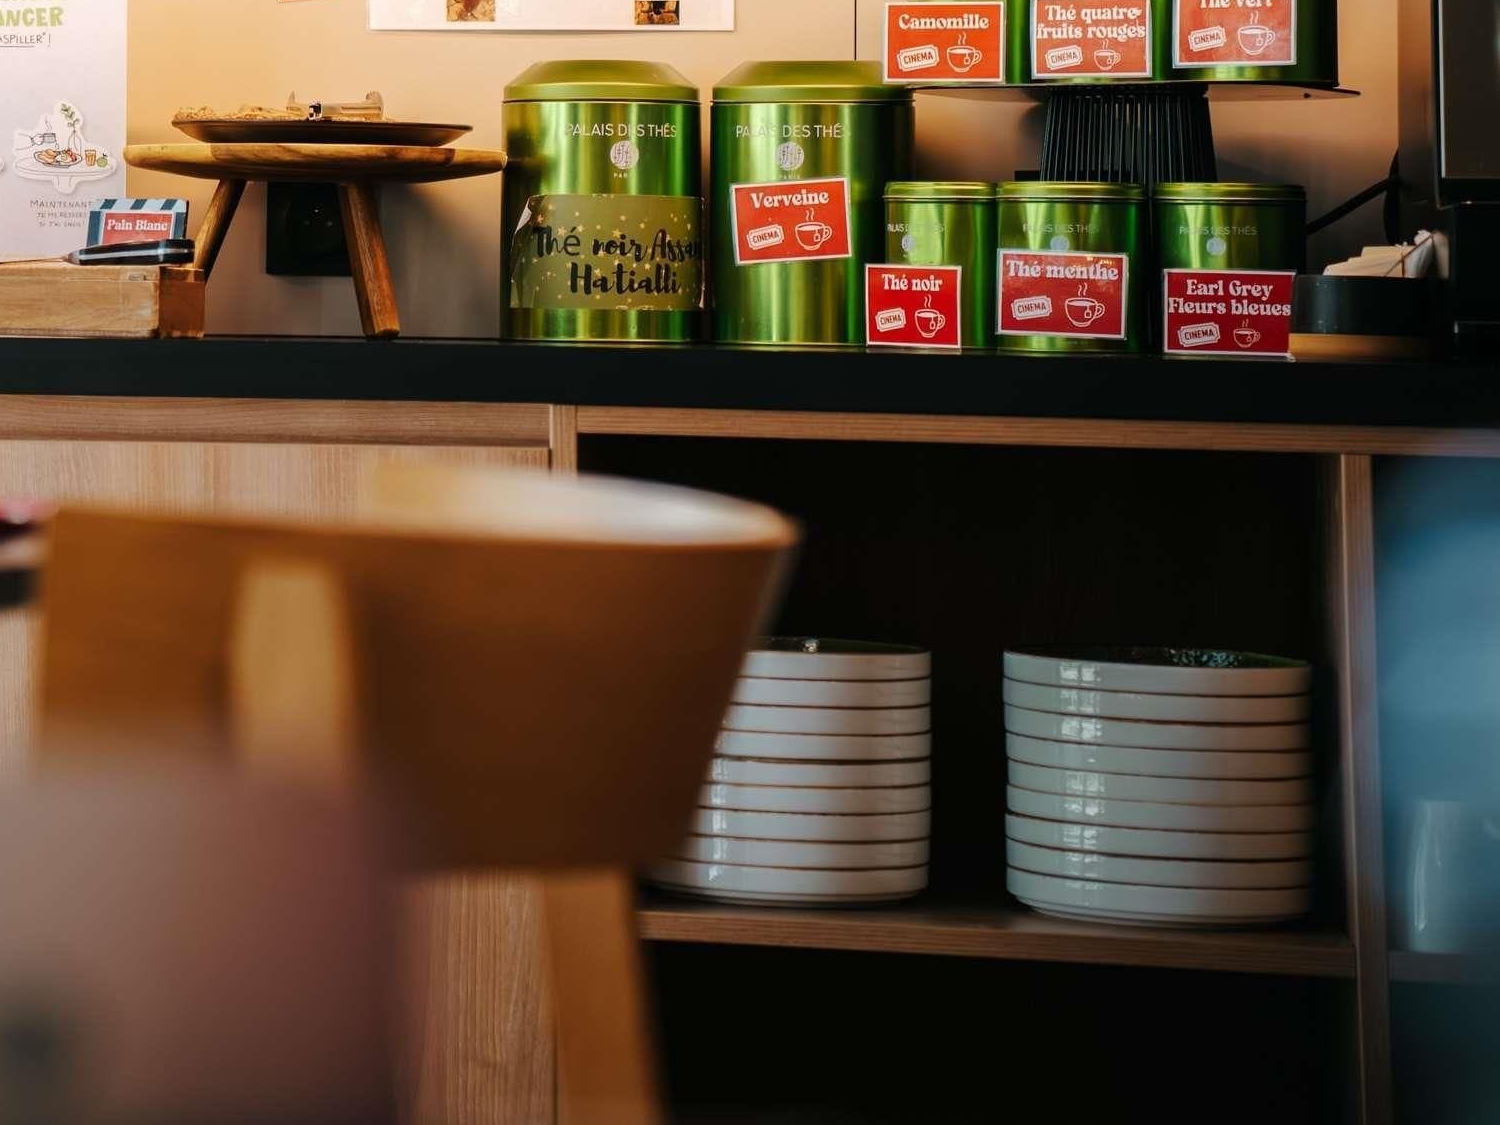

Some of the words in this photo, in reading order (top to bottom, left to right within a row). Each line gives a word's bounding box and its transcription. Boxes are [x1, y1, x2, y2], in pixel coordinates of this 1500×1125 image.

[898, 13, 990, 30] Camomille
[1045, 4, 1077, 21] Thé
[1081, 4, 1142, 24] quatre
[1037, 22, 1083, 39] fruits
[1087, 21, 1146, 42] rouges
[1194, 31, 1221, 46] CINEMA
[903, 50, 934, 65] CINEMA
[1050, 51, 1078, 65] CINEMA
[565, 123, 615, 137] PALAIS
[647, 121, 677, 138] THÉS
[782, 124, 811, 139] DES
[813, 122, 844, 139] THÉ
[30, 200, 93, 209] MAINTENANT
[751, 188, 830, 210] Verveine
[107, 219, 133, 231] Pain
[135, 219, 168, 231] Blanc
[532, 225, 581, 258] Thé
[592, 234, 647, 263] noir
[752, 230, 780, 245] CINEMA
[569, 262, 682, 295] Hatialli
[1006, 259, 1041, 278] Thé
[1046, 261, 1119, 281] menthe
[882, 273, 908, 291] Thé
[911, 274, 943, 292] noir
[1186, 279, 1225, 296] Earl
[1228, 279, 1274, 301] Grey
[1017, 301, 1047, 314] CINEMA
[1168, 297, 1227, 315] Fleurs
[1231, 298, 1292, 316] bleues
[880, 313, 902, 326] CINEMA
[1184, 328, 1215, 341] CINEMA
